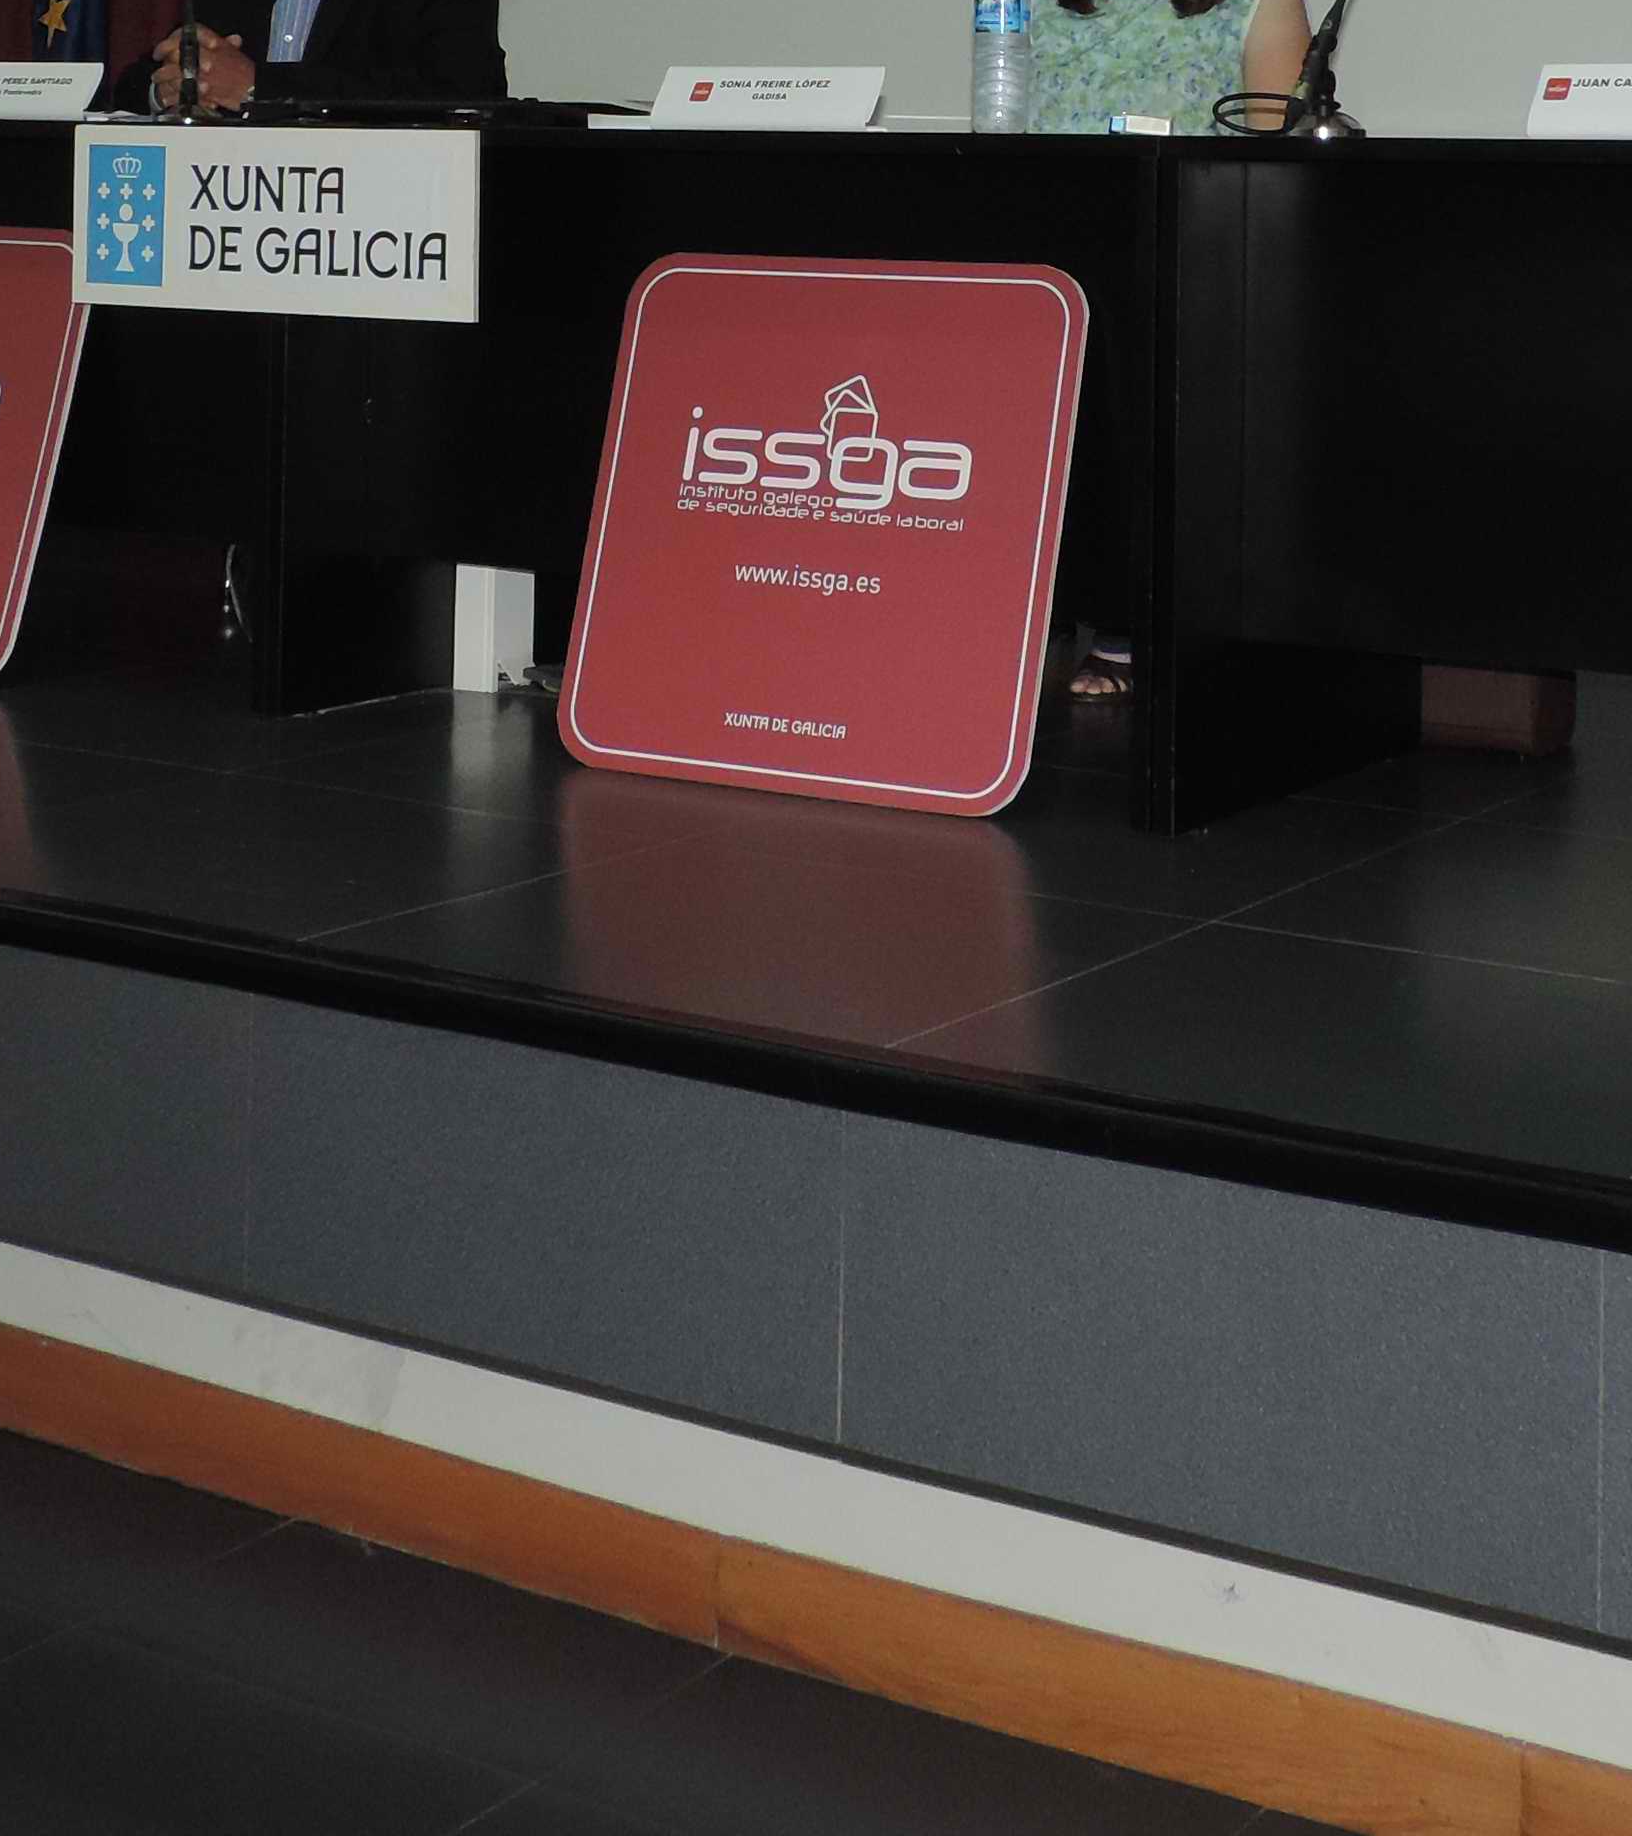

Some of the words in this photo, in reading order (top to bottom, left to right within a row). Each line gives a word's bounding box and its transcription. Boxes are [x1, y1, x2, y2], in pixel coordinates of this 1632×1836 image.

[719, 79, 752, 89] SONIA
[754, 79, 793, 89] FREIRE
[795, 78, 832, 89] LÓPEZ
[751, 92, 787, 101] GADISA
[1572, 78, 1610, 88] JUAN
[189, 164, 344, 214] XUNTA
[188, 224, 244, 273] DE
[255, 226, 448, 281] GALICIA
[681, 406, 973, 511] issga
[678, 482, 758, 502] instituto
[763, 490, 834, 510] galego
[676, 497, 701, 512] de
[704, 501, 810, 520] seguridade
[812, 509, 826, 522] e
[828, 509, 892, 527] saúde
[895, 513, 965, 532] laboral
[734, 563, 882, 597] www.issga.es
[723, 712, 771, 731] XUNTA
[771, 717, 790, 733] DE
[791, 720, 847, 740] GALICIA
